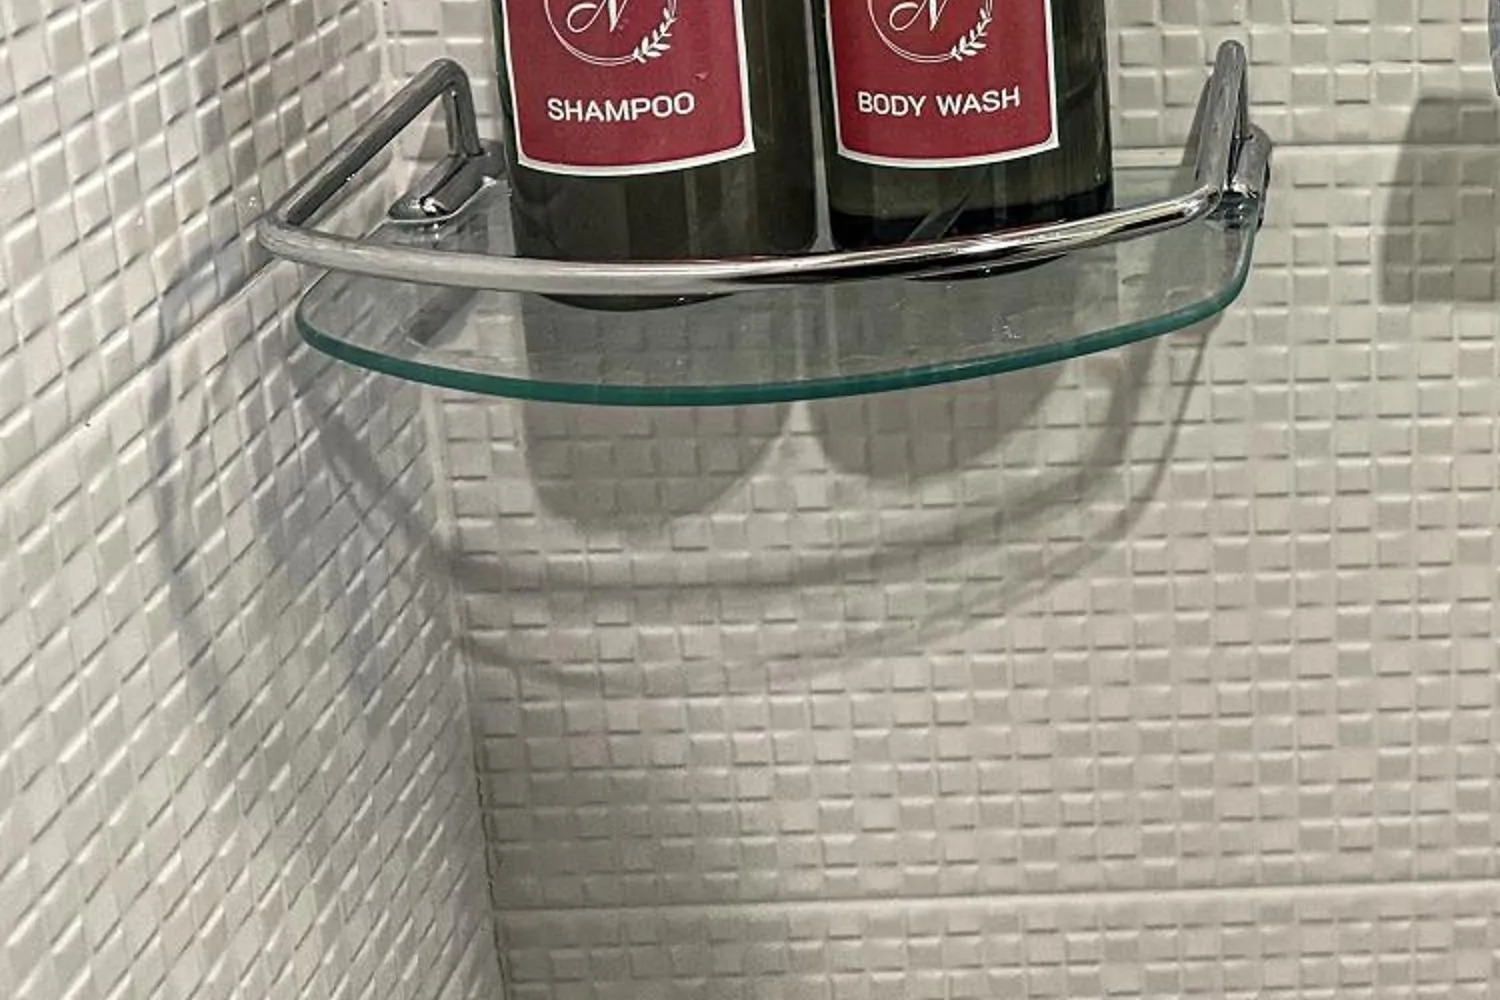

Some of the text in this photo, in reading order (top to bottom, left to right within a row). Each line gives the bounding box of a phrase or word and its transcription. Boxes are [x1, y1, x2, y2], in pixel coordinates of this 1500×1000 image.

[547, 92, 696, 122] SHAMPOO
[858, 85, 1021, 117] BODY WASH
